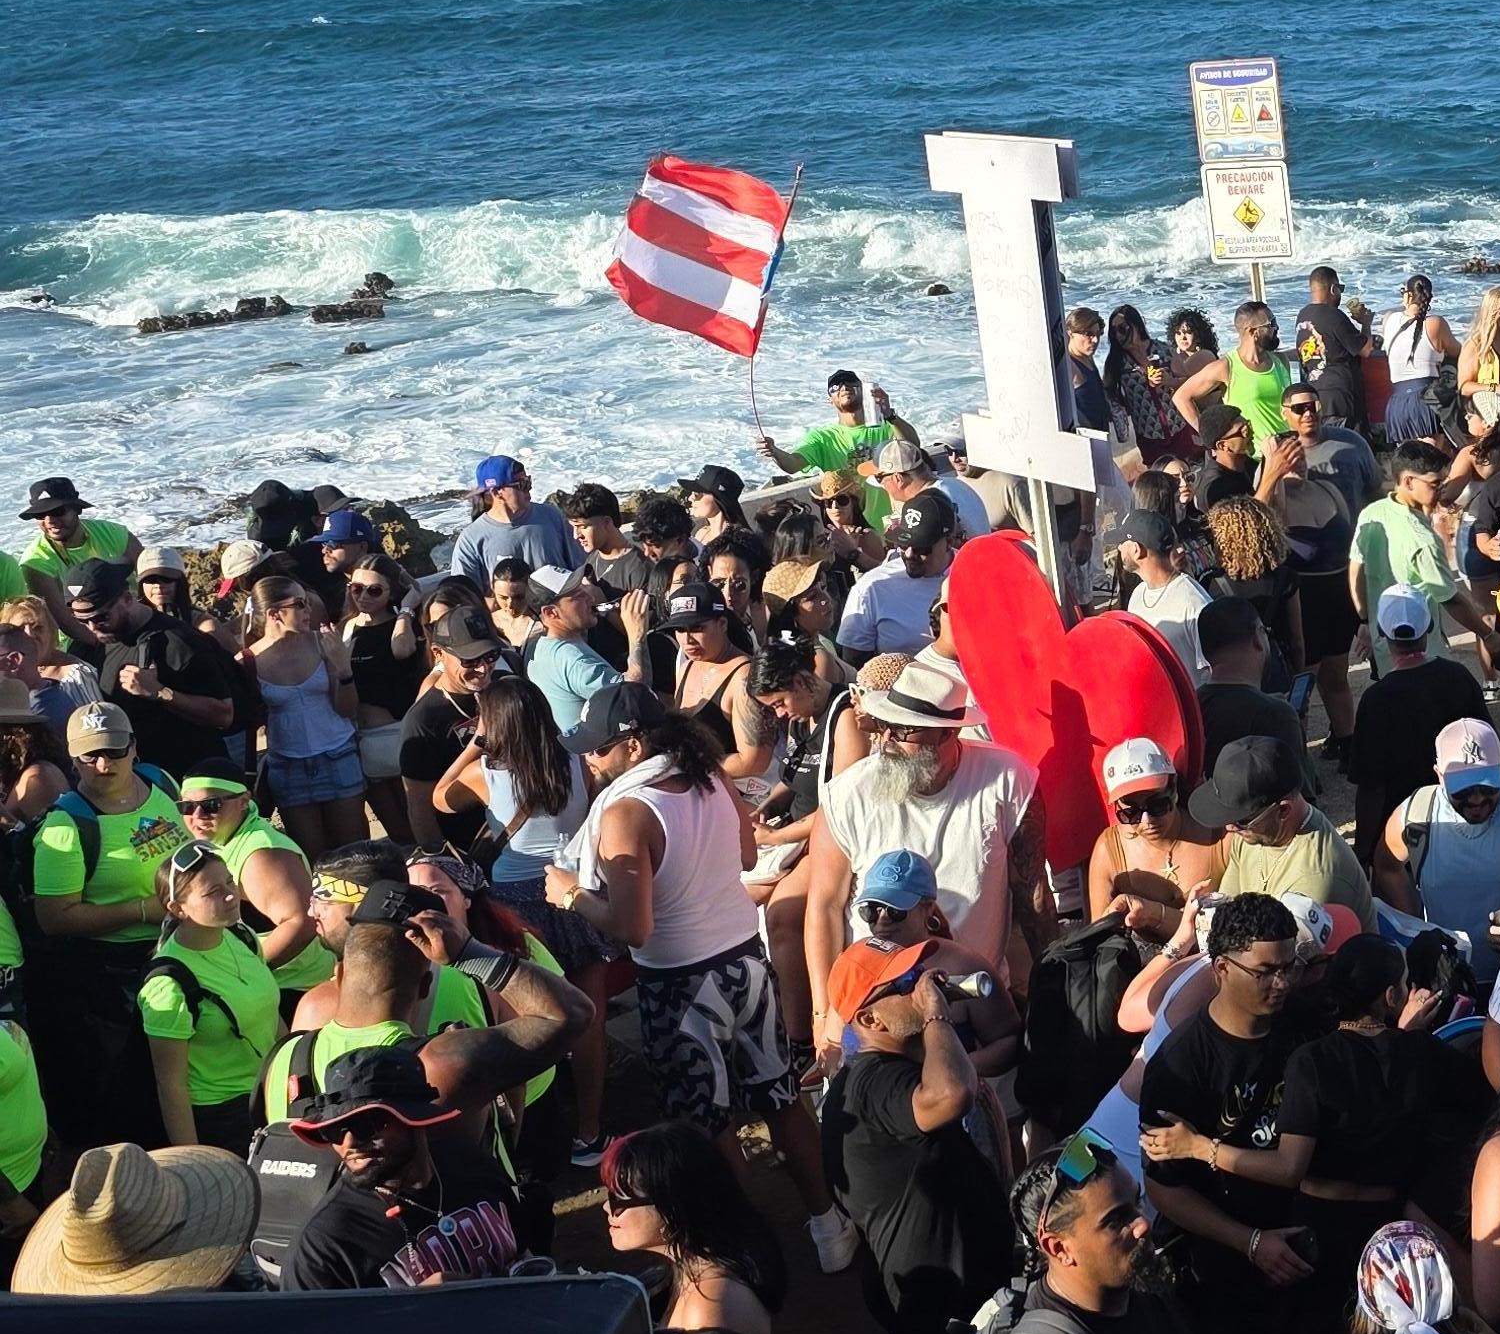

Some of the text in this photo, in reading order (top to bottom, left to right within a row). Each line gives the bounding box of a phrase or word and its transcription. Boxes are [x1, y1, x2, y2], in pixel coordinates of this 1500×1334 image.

[1216, 169, 1274, 183] PRECAUCIÓN
[1228, 184, 1265, 195] BEWARE
[80, 713, 108, 733] NY
[260, 1159, 318, 1179] RAIDERS
